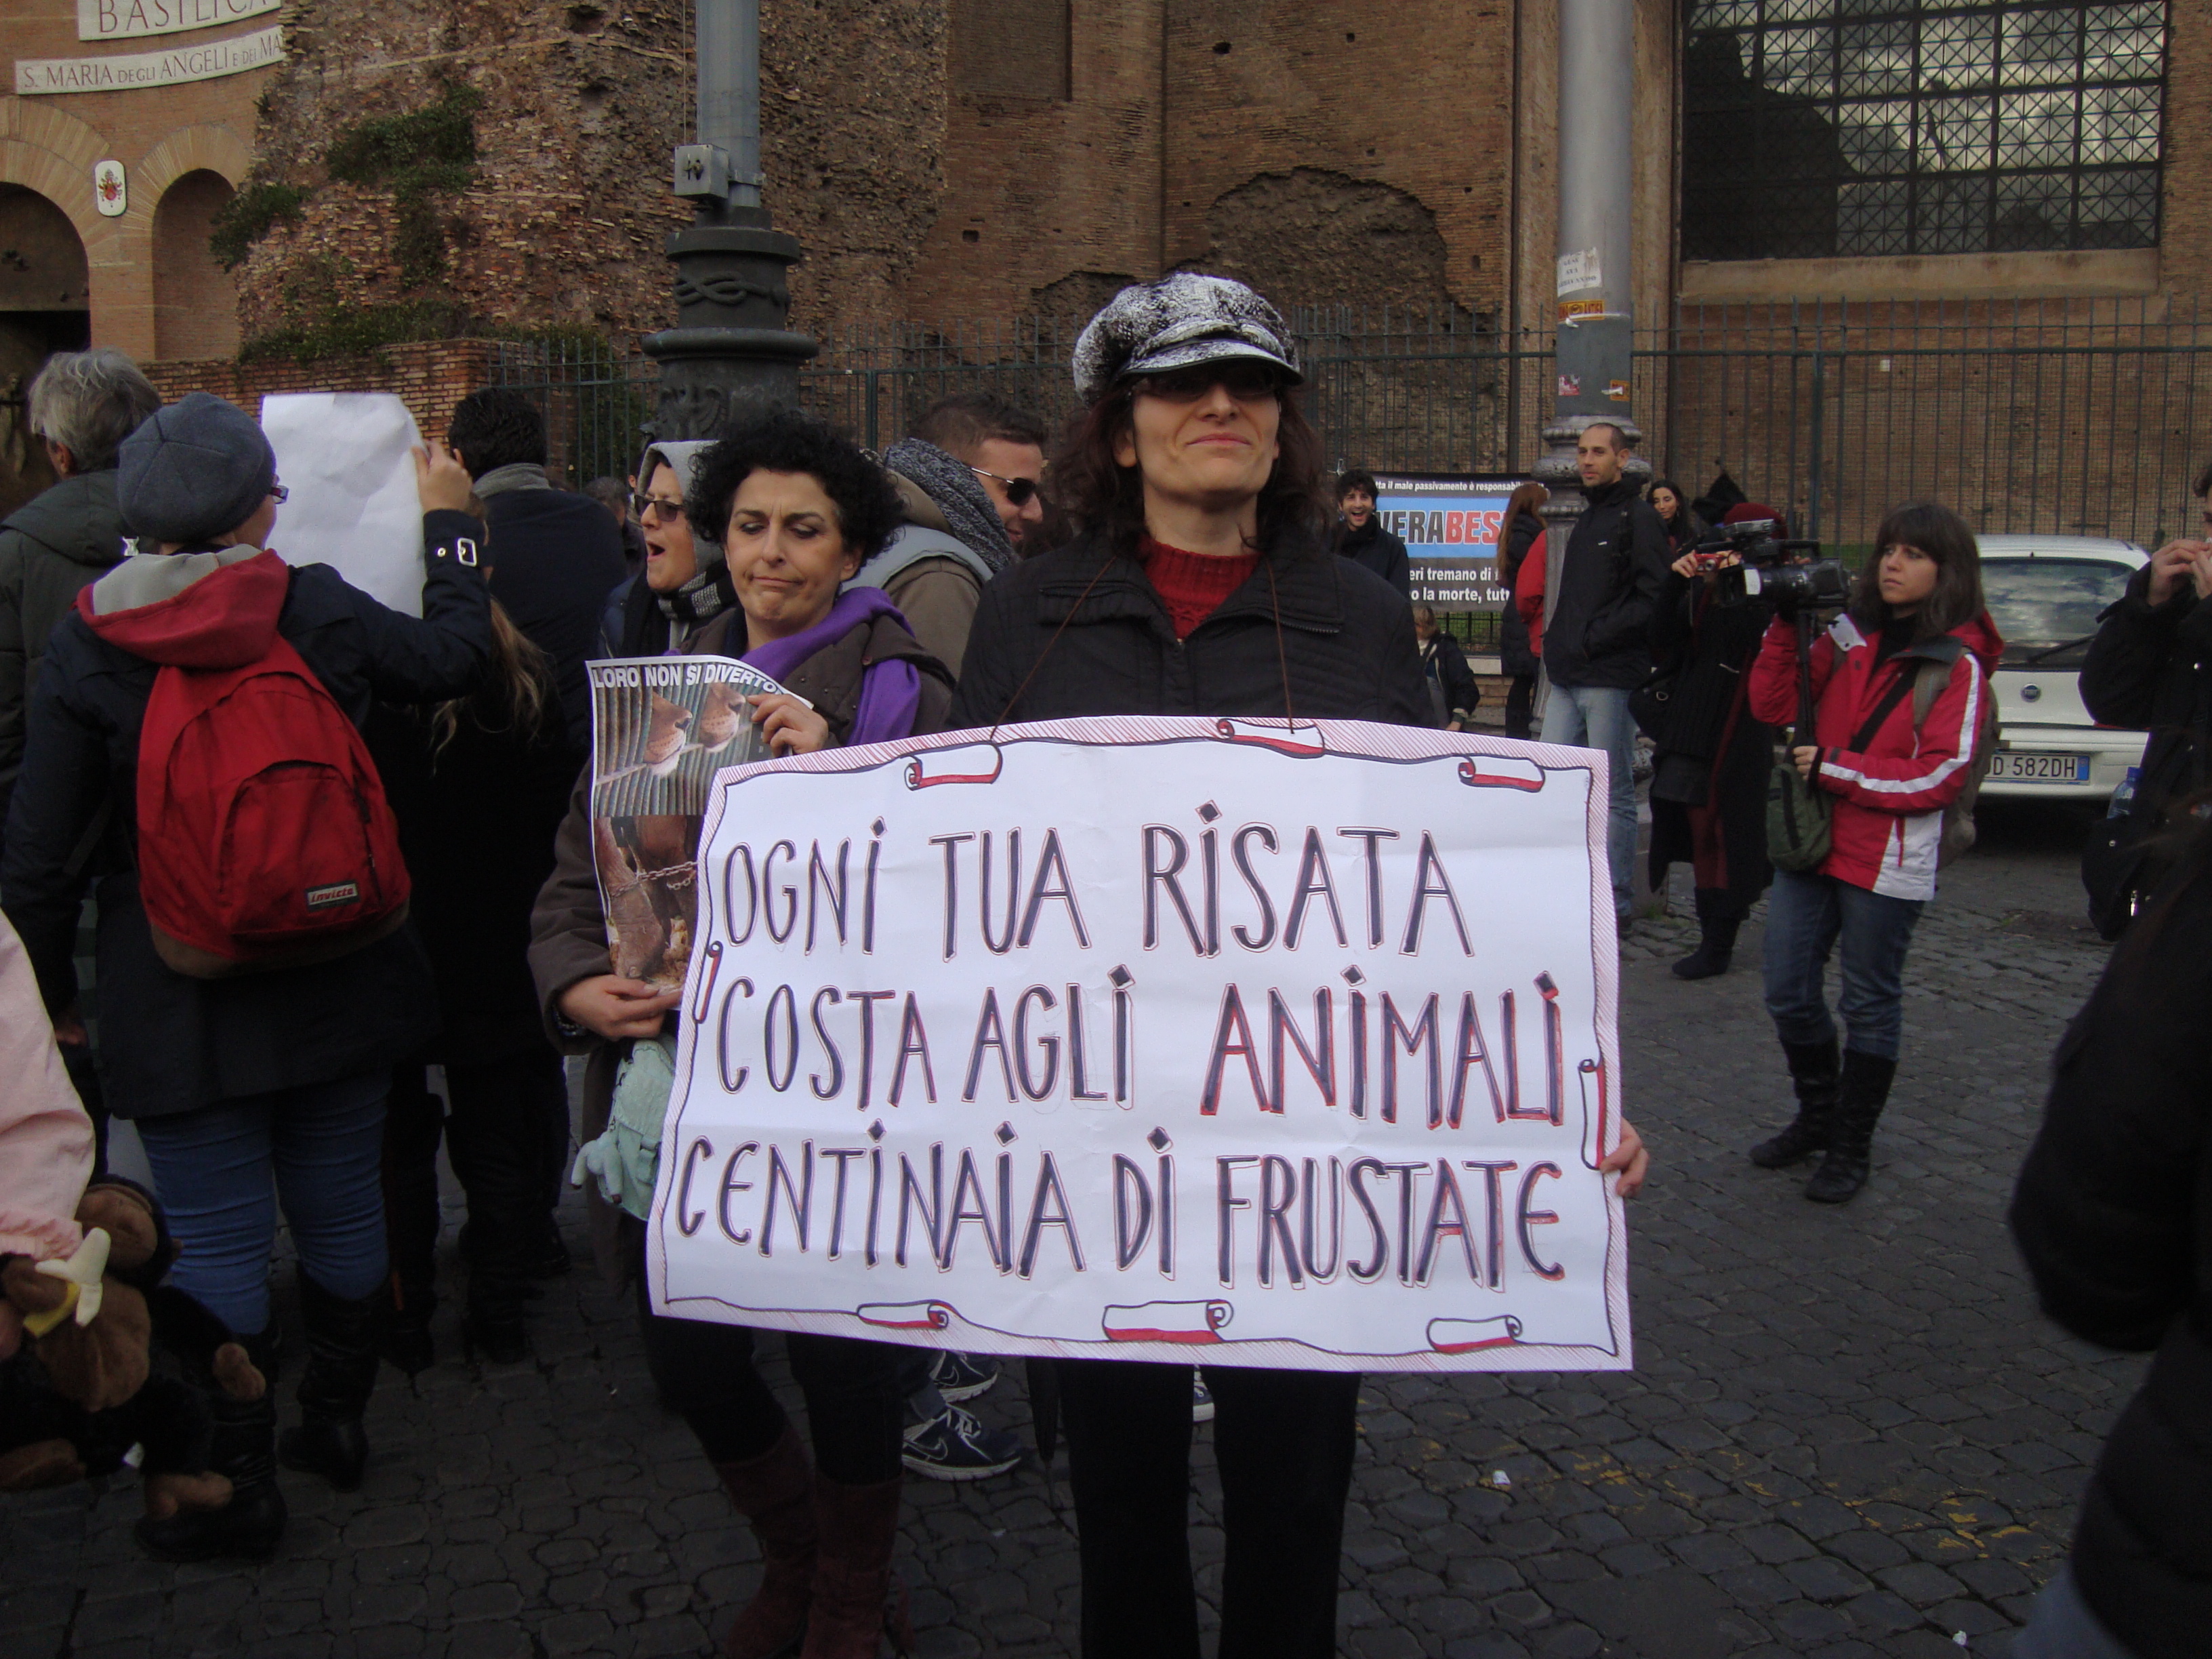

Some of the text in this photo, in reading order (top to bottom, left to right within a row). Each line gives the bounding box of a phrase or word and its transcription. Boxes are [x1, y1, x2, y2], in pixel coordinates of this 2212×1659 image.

[98, 0, 266, 33] BASIL
[24, 68, 38, 87] S.
[46, 64, 113, 87] MARIA
[118, 66, 156, 83] DEGLI
[161, 46, 228, 79] ANGELI
[232, 53, 239, 66] E
[242, 48, 257, 64] DEI
[1387, 480, 1394, 489] il
[1395, 480, 1413, 490] male
[1414, 480, 1467, 492] passivamente
[1469, 480, 1475, 491] è
[1476, 481, 1524, 493] responsabil
[1374, 510, 1507, 545] VERABES
[1427, 567, 1477, 581] tremano
[1480, 567, 1492, 581] di
[1423, 586, 1435, 601] la
[1438, 587, 1482, 605] morte,
[592, 667, 640, 689] LORO
[645, 665, 680, 687] NON
[686, 665, 701, 686] SI
[2012, 756, 2075, 778] 582DH
[723, 802, 1472, 961] OGNI TUA RISATA
[718, 965, 1563, 1130] COSTA AGLI ANIMALI
[677, 1120, 1564, 1291] CENTINAIA DI FRUSTATE
